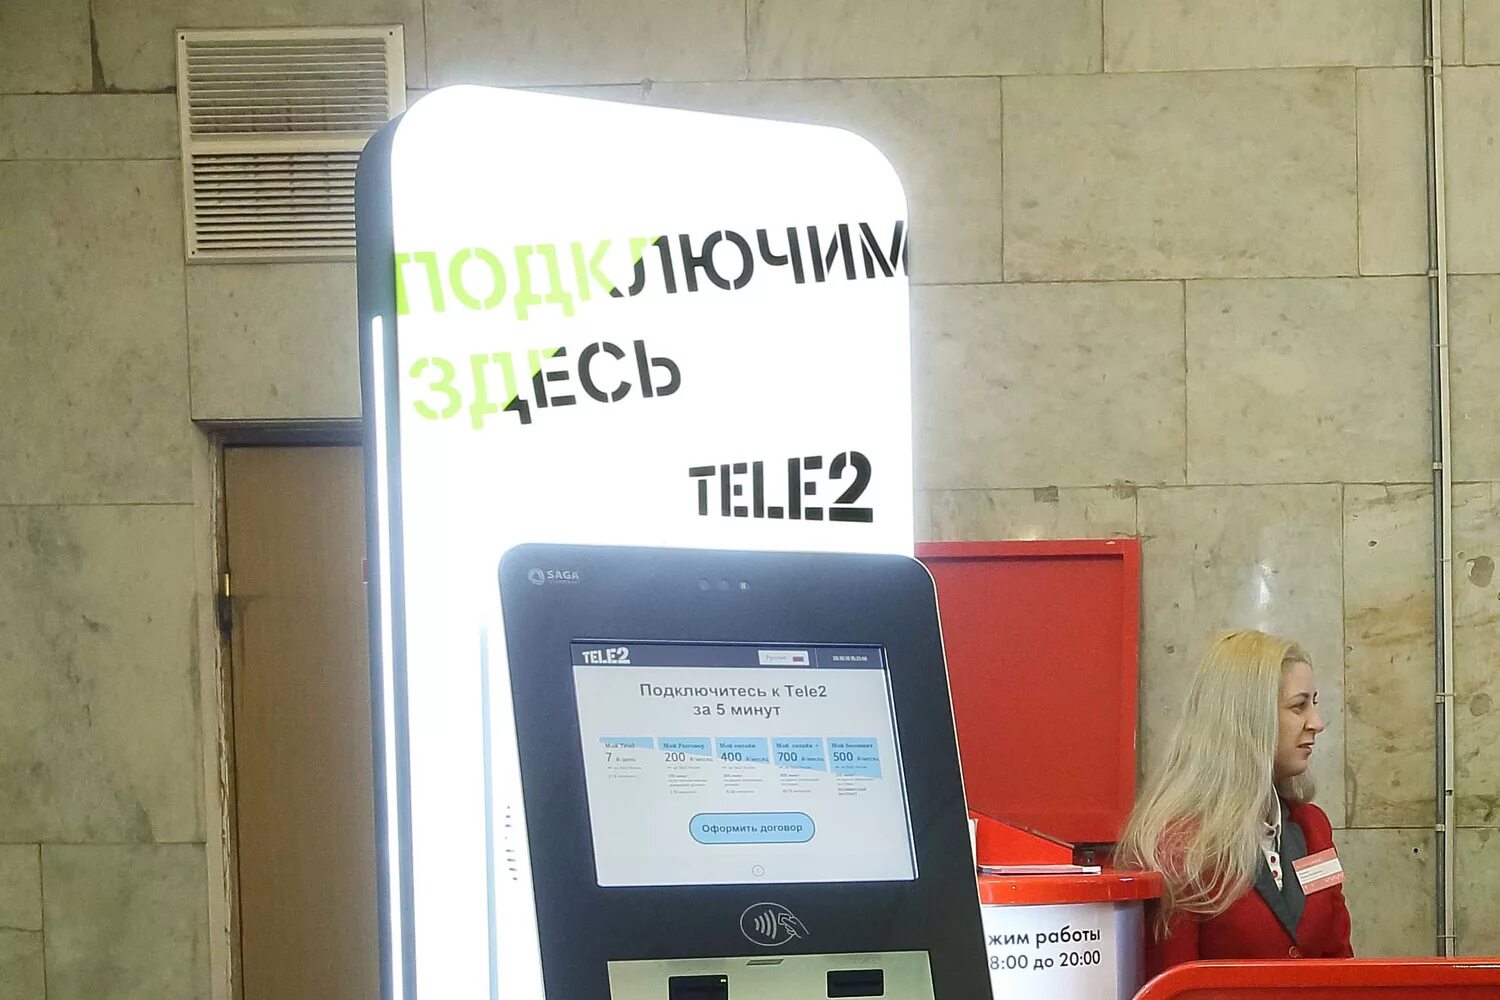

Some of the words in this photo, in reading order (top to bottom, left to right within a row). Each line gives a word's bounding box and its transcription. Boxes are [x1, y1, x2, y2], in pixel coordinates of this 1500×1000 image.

[395, 220, 908, 320] ПОДКЛЮЧИМ
[409, 340, 682, 429] ЗДЕСЬ
[689, 451, 873, 523] TELE2
[547, 570, 580, 580] SAGA
[582, 647, 631, 665] TELE2
[640, 683, 767, 699] Подключитесь
[772, 687, 780, 697] к
[784, 684, 827, 698] Tele2
[693, 705, 712, 715] за
[717, 703, 726, 715] 5
[731, 705, 782, 718] минут
[606, 752, 612, 762] 7
[664, 752, 686, 762] 200
[720, 752, 742, 762] 400
[778, 751, 798, 762] 700
[833, 751, 854, 762] 500
[701, 824, 757, 835] Оформить
[760, 824, 803, 834] договор
[1036, 925, 1101, 949] работы
[1033, 958, 1054, 971] до
[1059, 950, 1101, 967] 20:00
